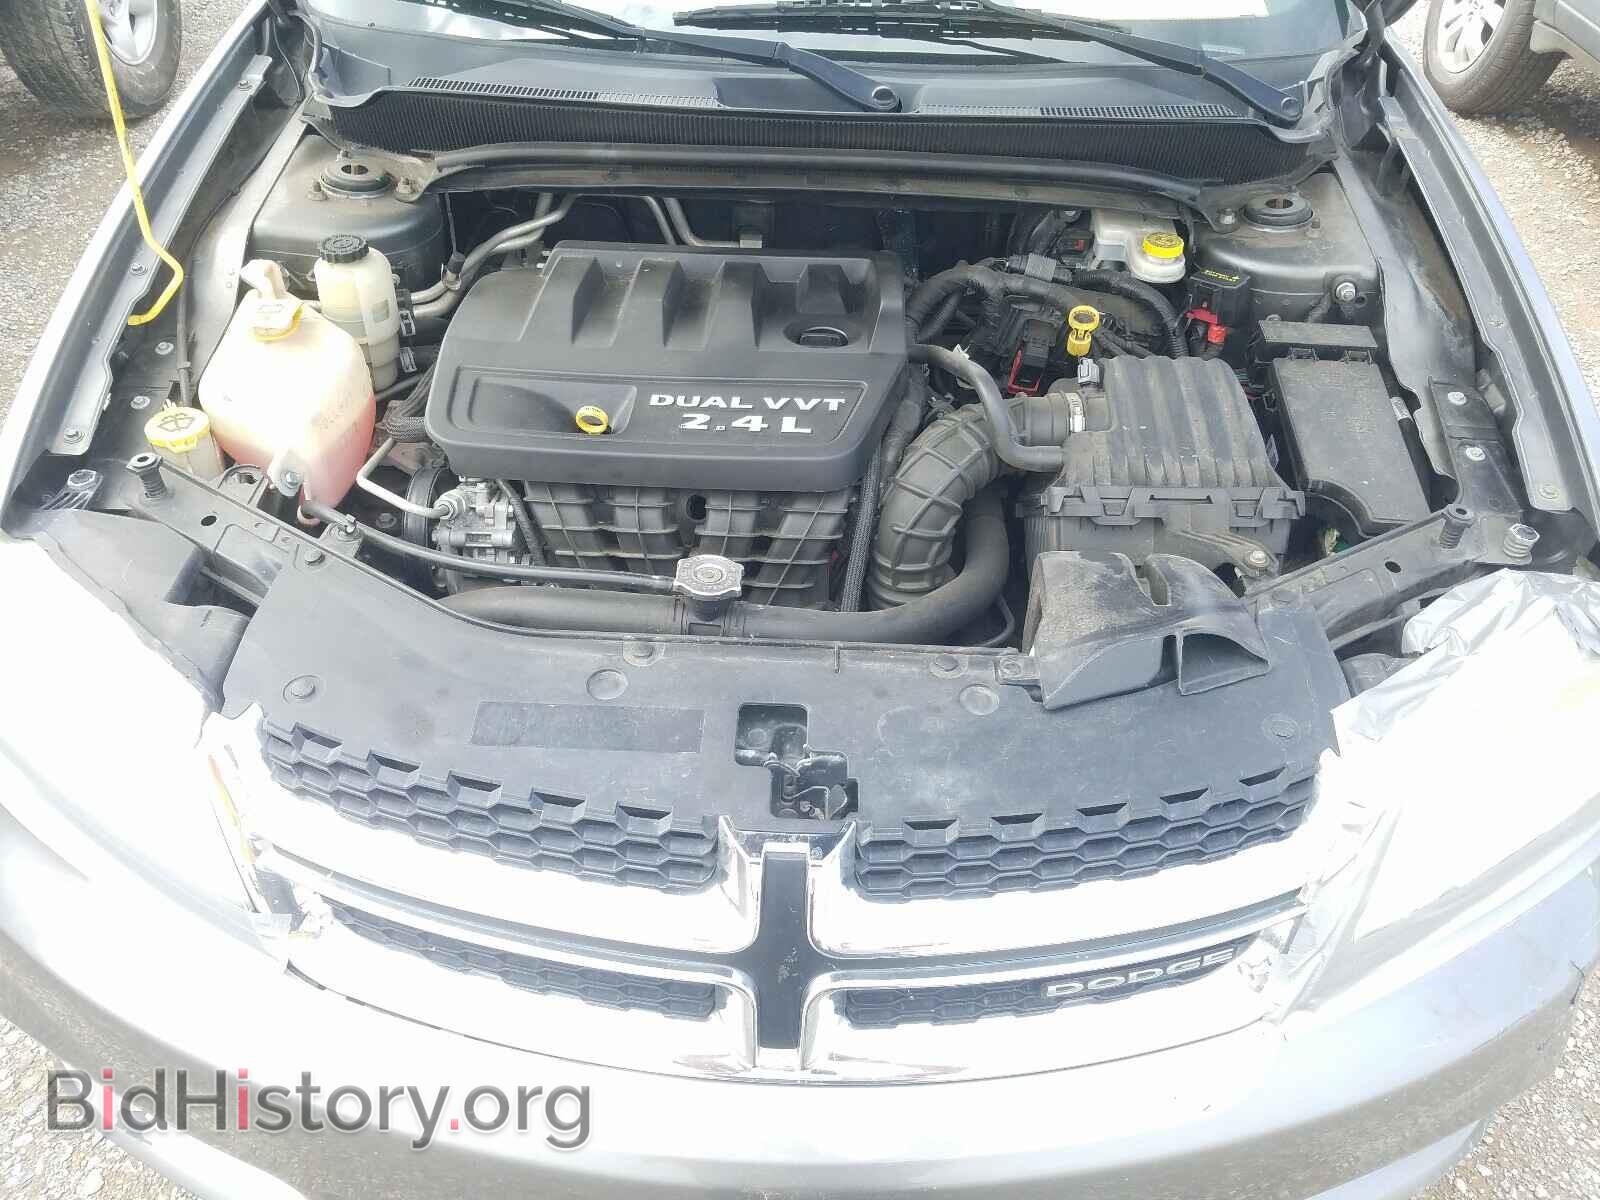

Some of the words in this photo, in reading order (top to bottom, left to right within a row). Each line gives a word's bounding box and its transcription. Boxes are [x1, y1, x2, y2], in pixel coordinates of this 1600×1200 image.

[649, 394, 753, 408] DUAL
[763, 397, 846, 411] VVT
[1046, 948, 1234, 997] DODGE
